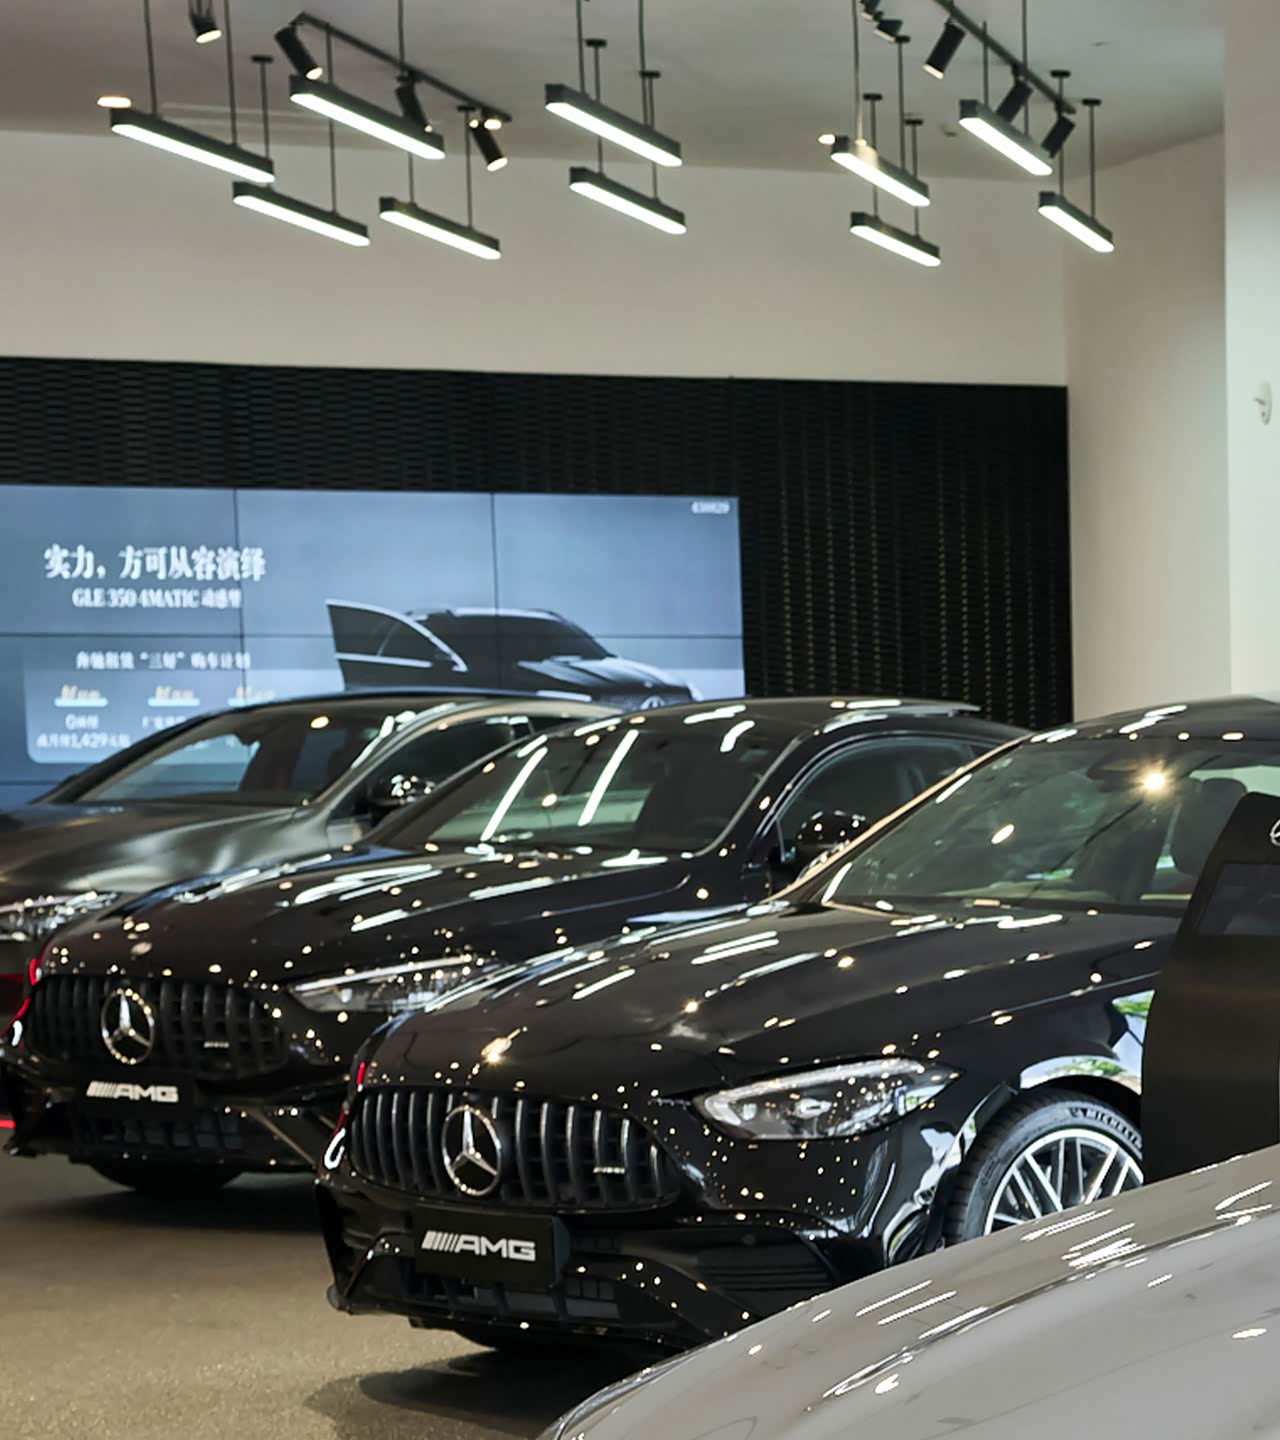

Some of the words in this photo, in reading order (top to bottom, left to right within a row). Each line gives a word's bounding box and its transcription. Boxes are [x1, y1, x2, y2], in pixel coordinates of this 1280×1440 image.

[72, 588, 106, 608] GLE
[107, 588, 137, 608] 350
[113, 1082, 179, 1103] AMG
[454, 1233, 536, 1261] AMG
